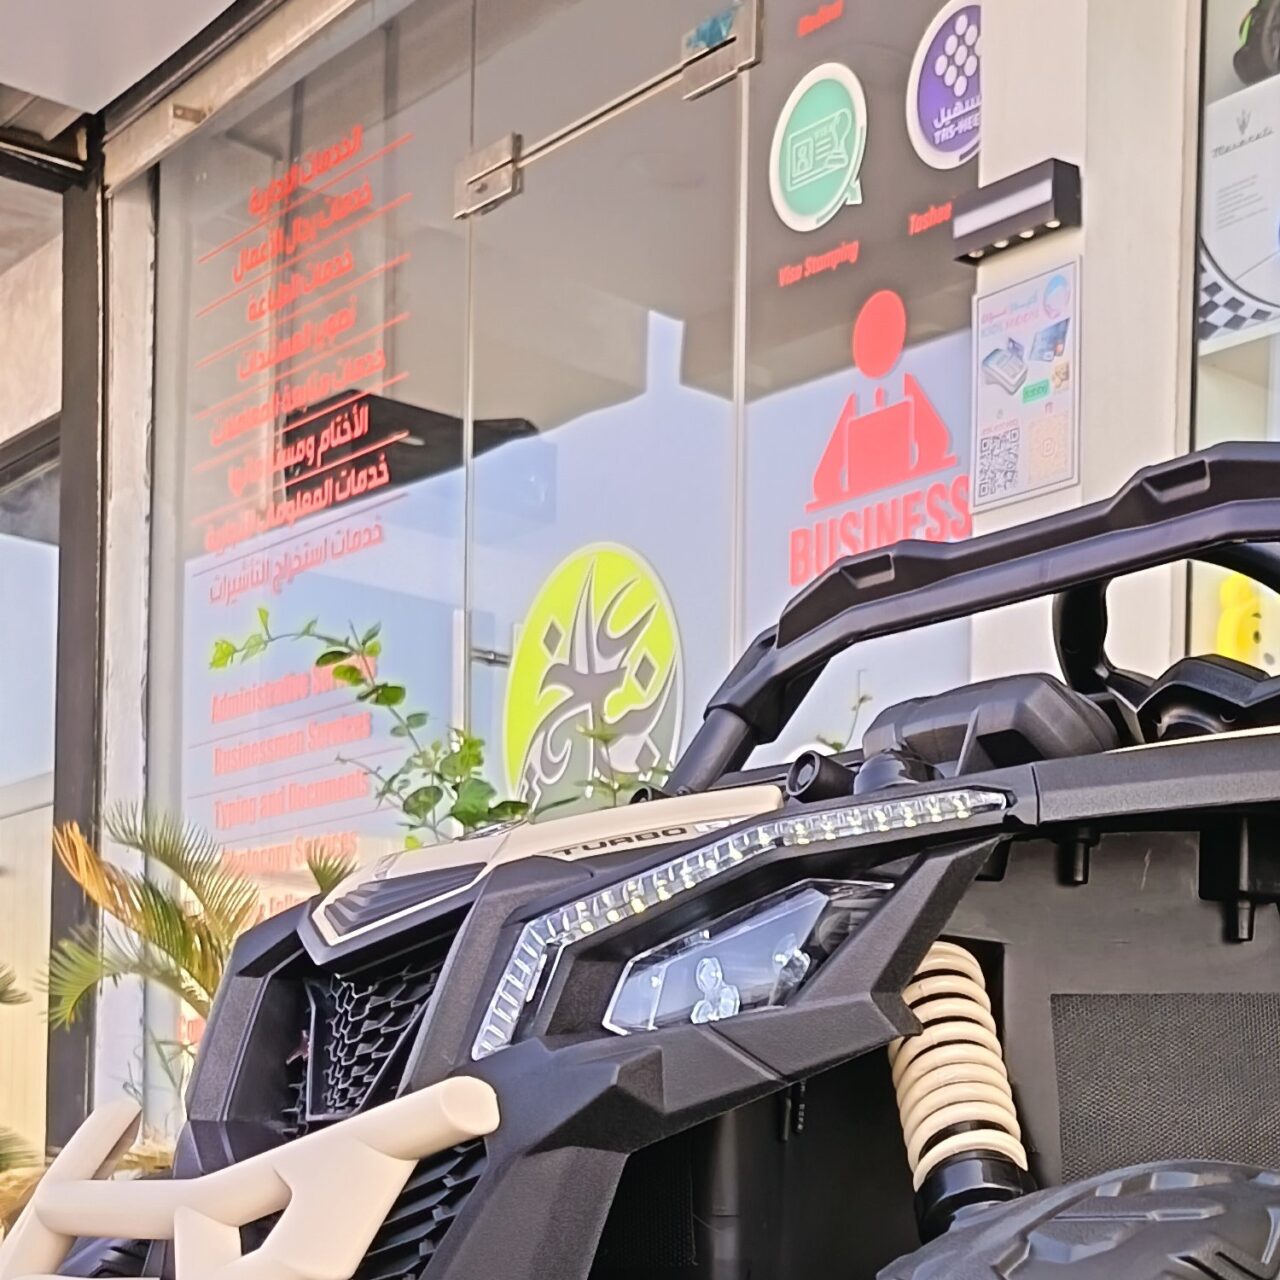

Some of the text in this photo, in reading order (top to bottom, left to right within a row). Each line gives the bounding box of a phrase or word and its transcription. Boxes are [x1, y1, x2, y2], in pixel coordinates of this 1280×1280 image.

[933, 113, 981, 145] TAS-HEE
[317, 402, 369, 467] الأختام
[334, 452, 390, 502] خدمات
[330, 514, 385, 560] خدمات
[788, 473, 973, 588] BUSINESS
[551, 826, 688, 857] TURBO
